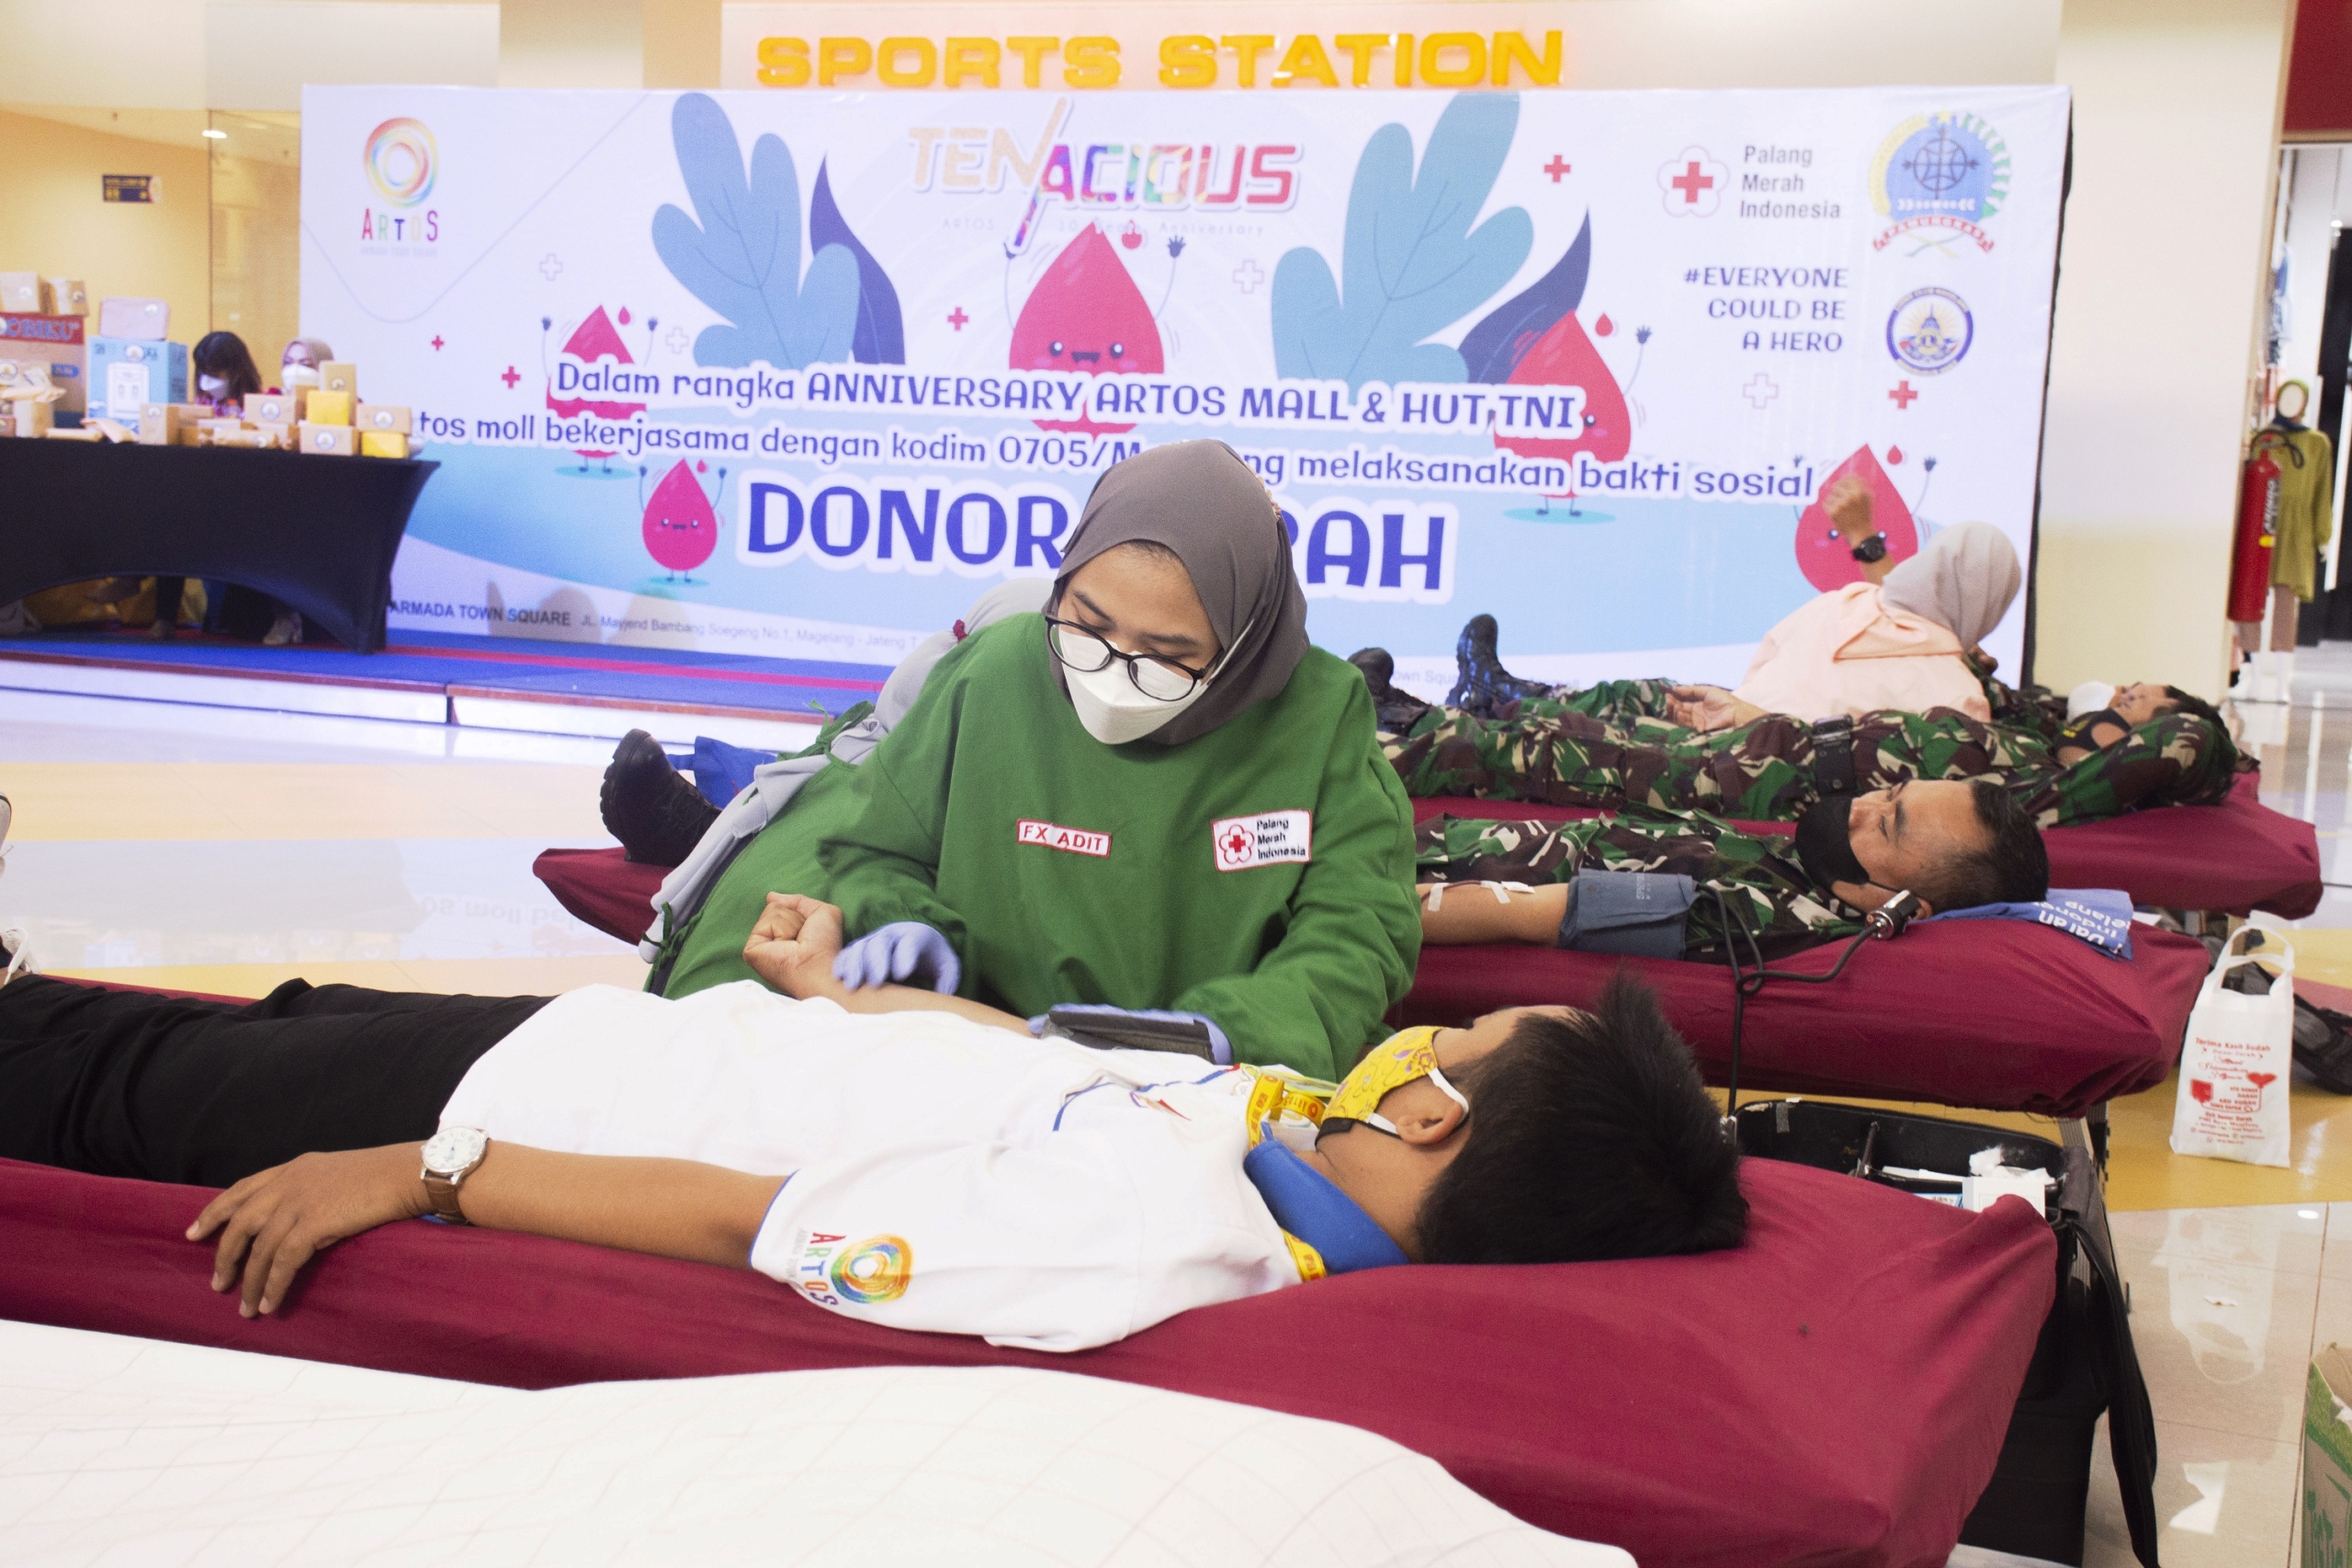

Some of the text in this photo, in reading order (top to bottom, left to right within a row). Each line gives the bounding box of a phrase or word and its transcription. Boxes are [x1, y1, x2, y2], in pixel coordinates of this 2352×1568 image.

[757, 30, 1565, 88] SPORTS STATION
[1744, 145, 1814, 169] Palang
[910, 97, 1297, 244] TENACIOUS
[1742, 174, 1804, 193] Merah
[1739, 199, 1841, 220] Indonesia
[361, 209, 439, 243] ARTOS
[1684, 266, 1849, 288] #EVERYONE
[1709, 299, 1846, 321] COULD BE
[1742, 332, 1843, 353] A HERO
[559, 362, 1576, 429] Dalam rangka ANNIVERSARY ARTOS MALL & HUT TNI
[420, 412, 466, 438] tos
[477, 414, 535, 441] moll
[547, 416, 749, 457] bekerjasama
[761, 427, 879, 465] dengan
[893, 432, 986, 462] kodim
[1298, 450, 1566, 488] melaksanakan
[1580, 459, 1680, 491] bakti
[1694, 467, 1813, 497] sosial
[748, 481, 1069, 569] DONOR
[390, 600, 455, 617] ARMADA
[459, 604, 503, 621] TOWN
[508, 608, 572, 626] SQUARE
[1257, 818, 1289, 831] Palang
[1023, 825, 1103, 852] FX ADIT
[1258, 833, 1286, 845] Merah
[1258, 845, 1306, 859] Indonesia
[800, 1232, 847, 1306] ARTOS
